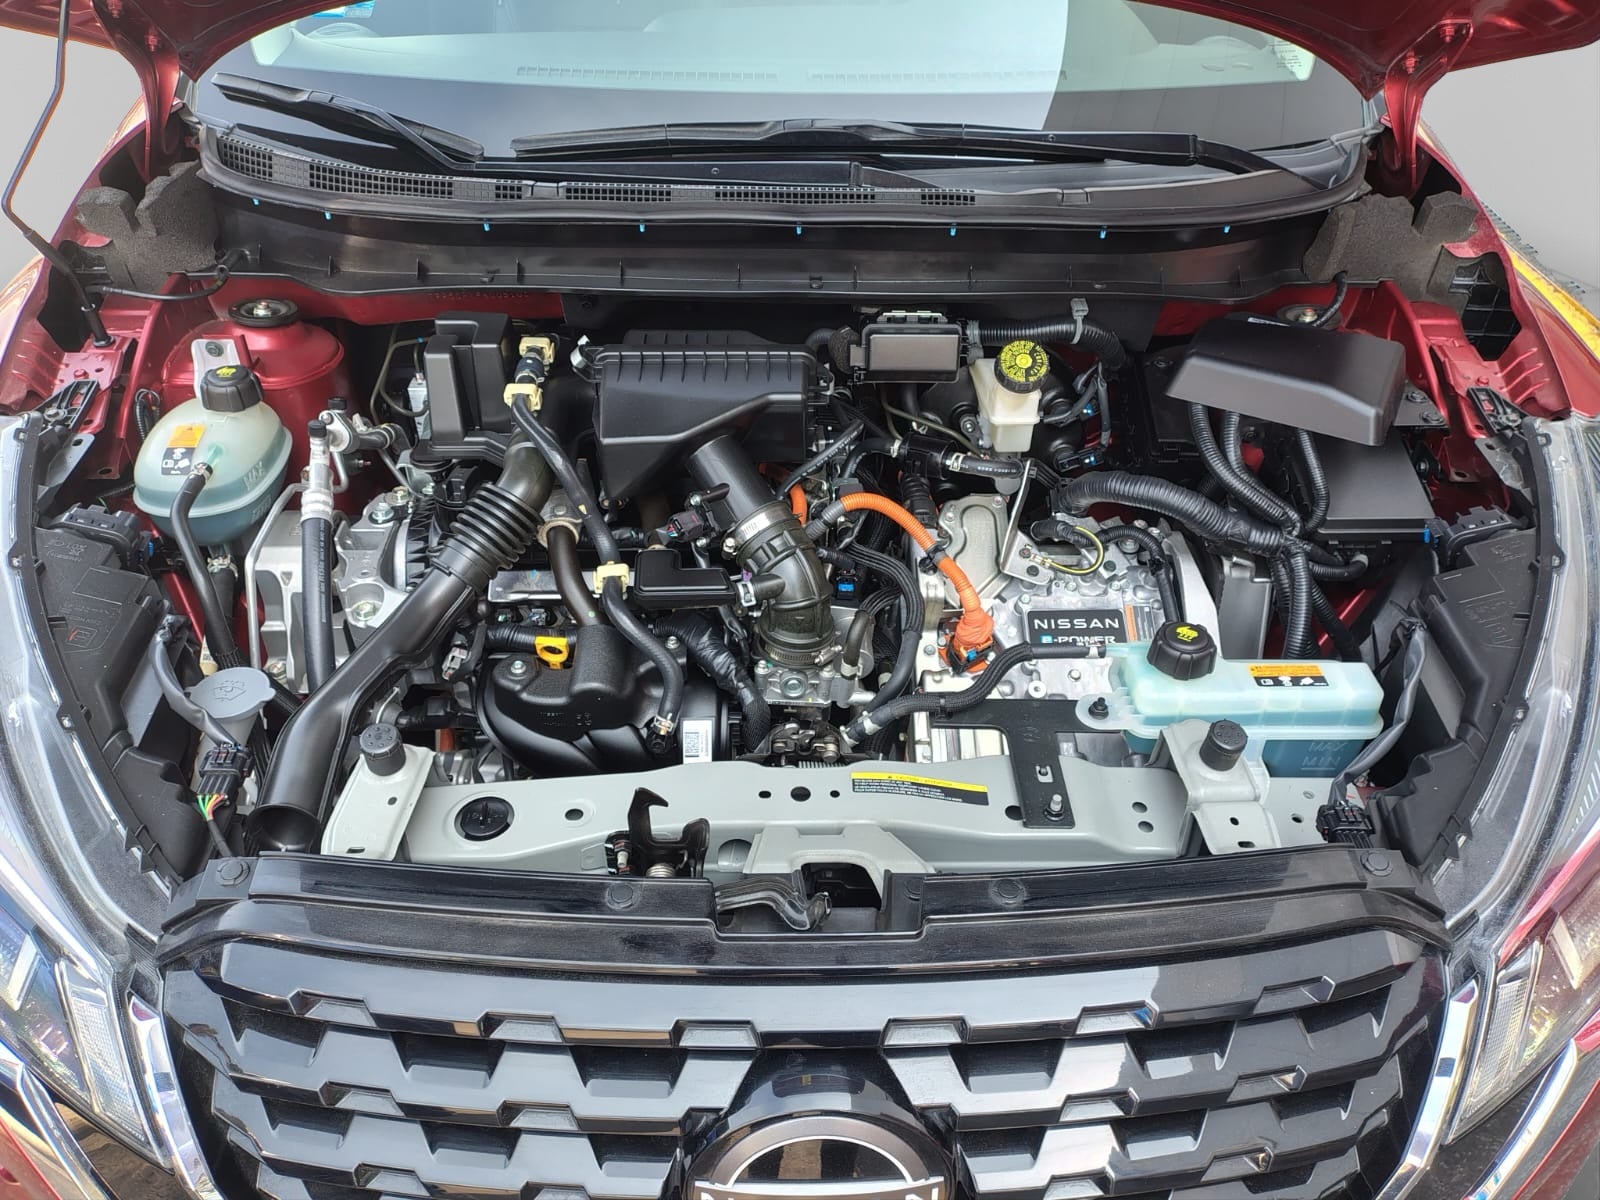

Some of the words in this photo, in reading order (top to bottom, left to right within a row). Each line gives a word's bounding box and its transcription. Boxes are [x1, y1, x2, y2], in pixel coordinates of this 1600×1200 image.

[1034, 618, 1120, 630] NISSAN
[1308, 742, 1348, 752] MAX
[1302, 756, 1341, 767] MIN
